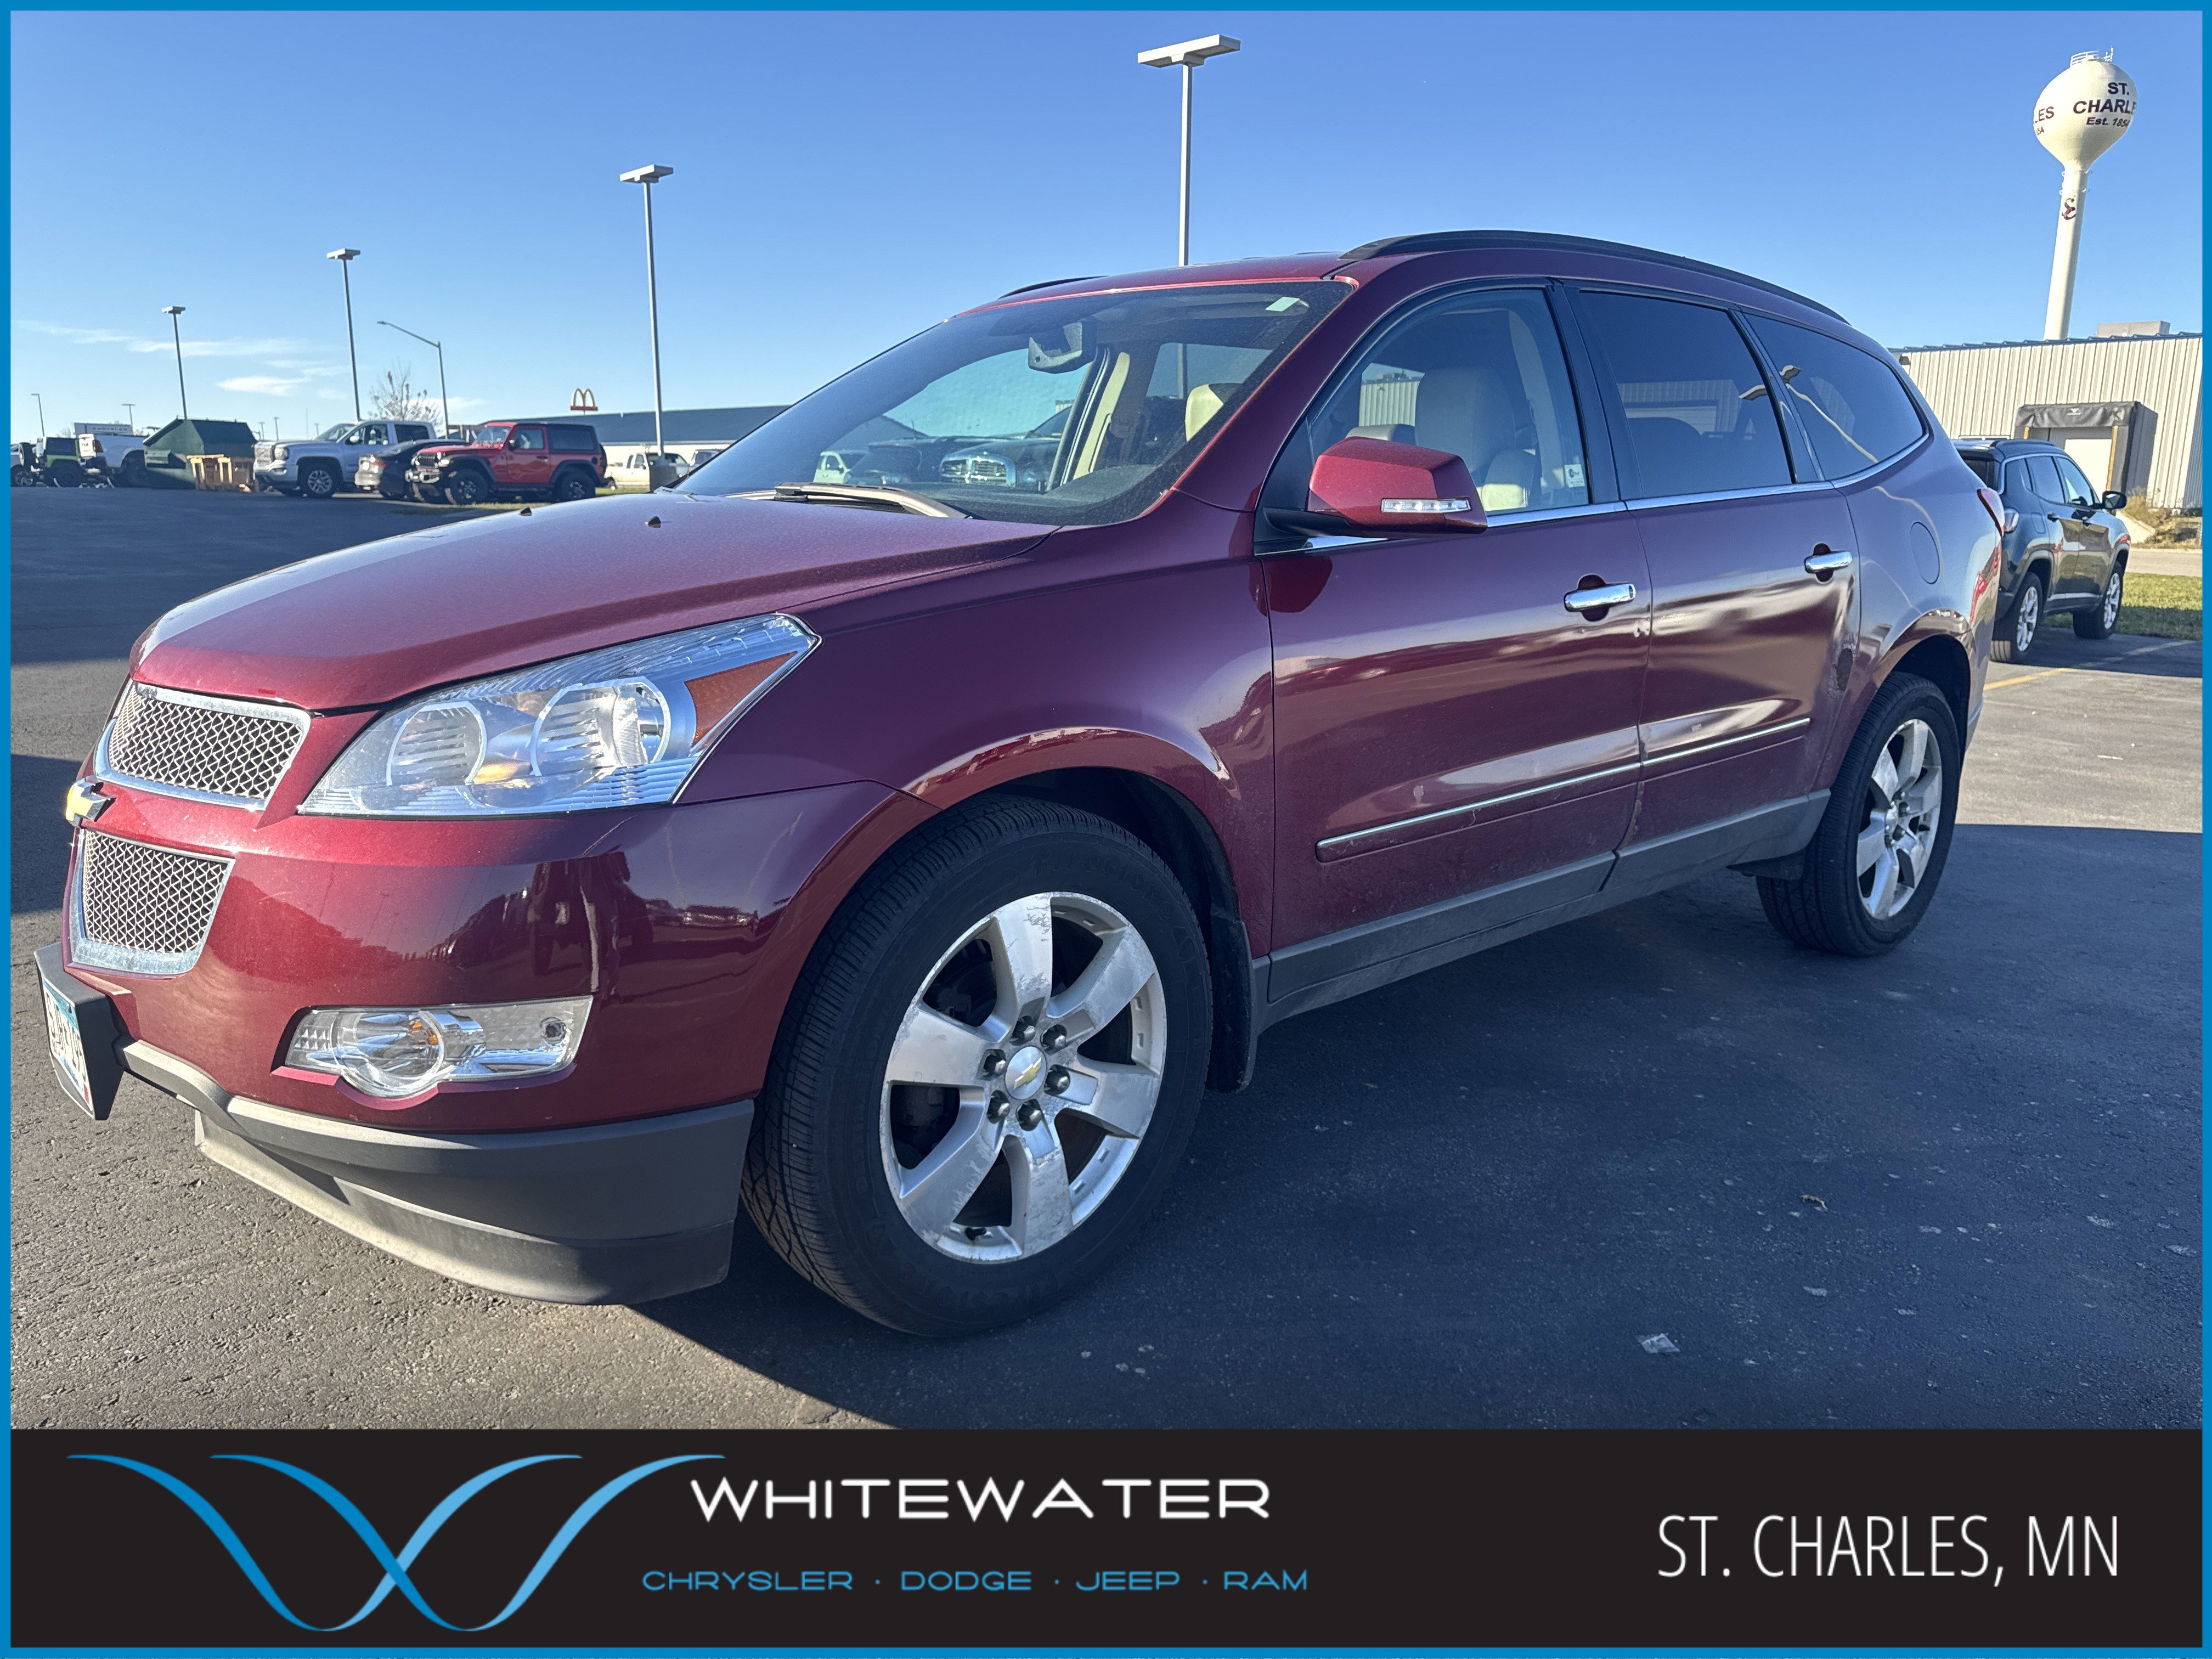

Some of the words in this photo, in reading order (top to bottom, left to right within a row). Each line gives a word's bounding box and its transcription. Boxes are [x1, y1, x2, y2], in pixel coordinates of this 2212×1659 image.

[2107, 82, 2130, 95] ST.
[2086, 117, 2108, 126] Est.
[1029, 849, 1174, 923] Firestone
